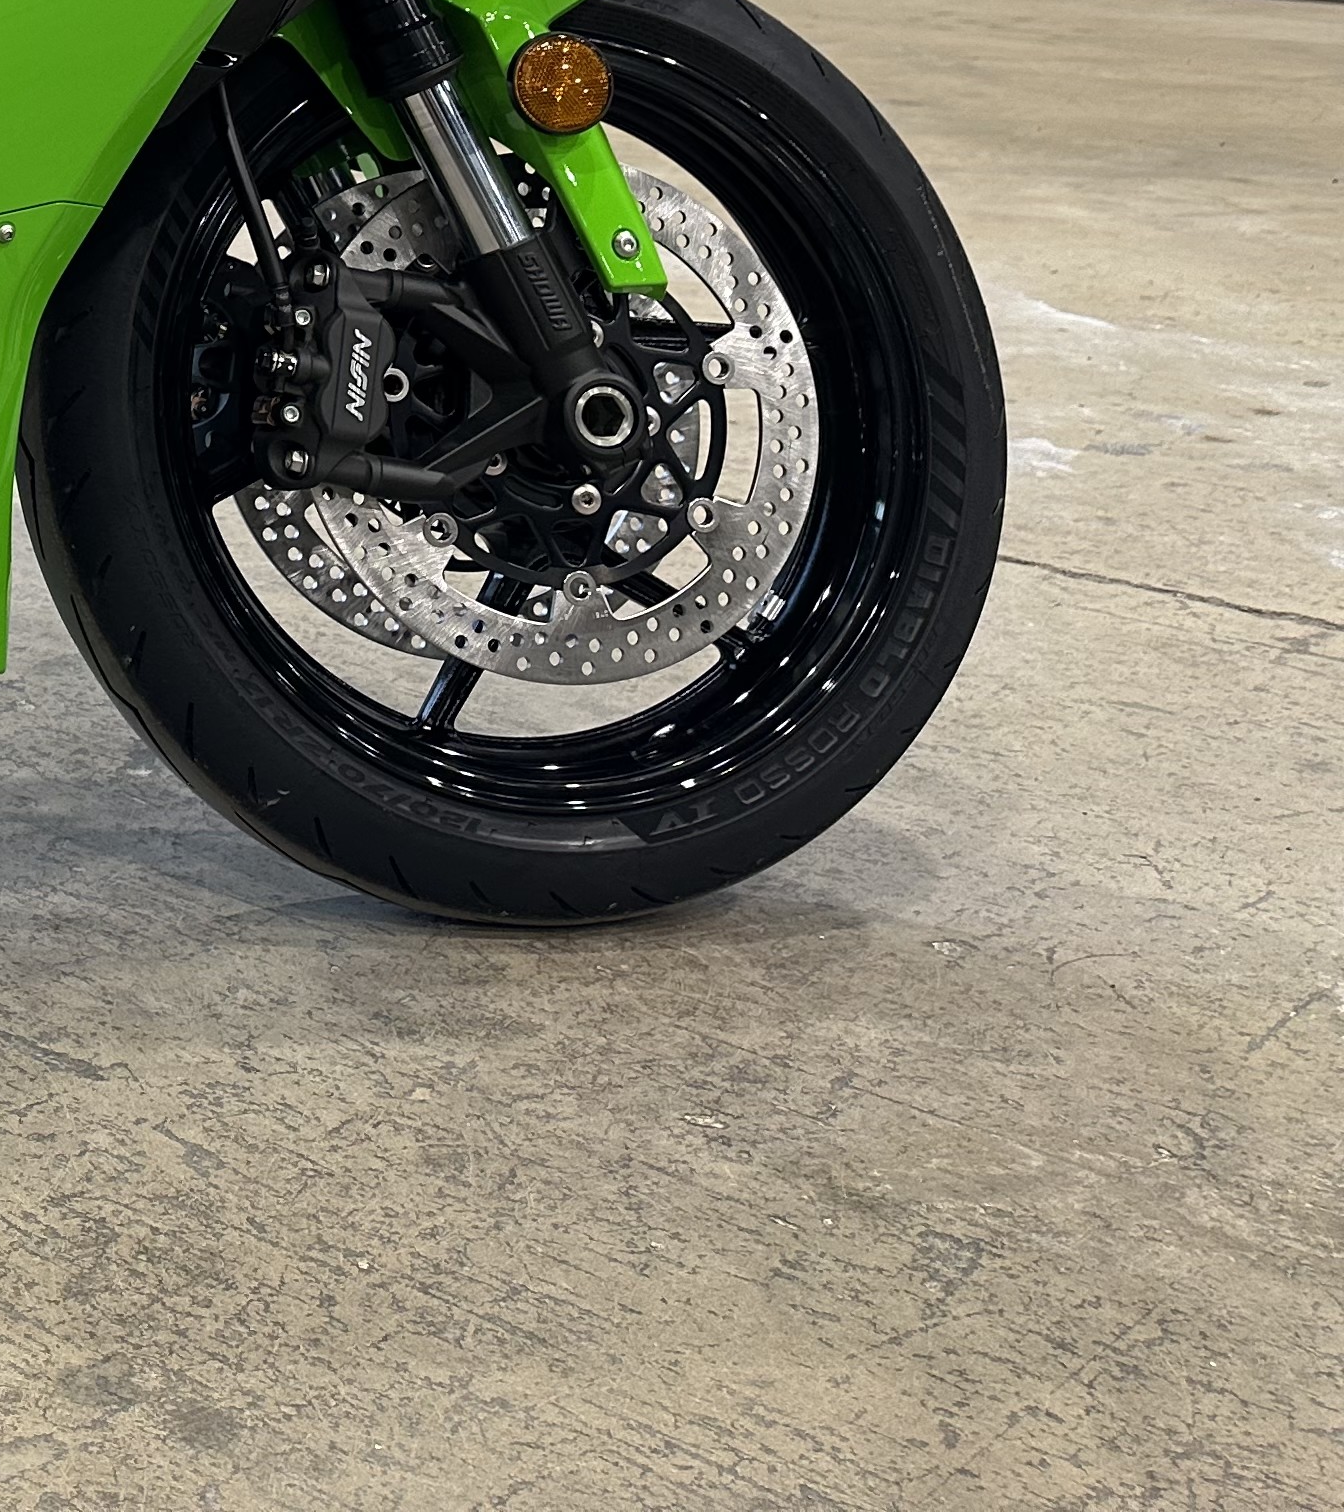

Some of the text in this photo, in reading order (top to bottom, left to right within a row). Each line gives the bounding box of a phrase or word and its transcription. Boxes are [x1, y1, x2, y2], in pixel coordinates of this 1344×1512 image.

[517, 251, 572, 331] SHOWA
[345, 328, 372, 421] NISSIN
[649, 534, 951, 836] DIABLO ROSSO IV
